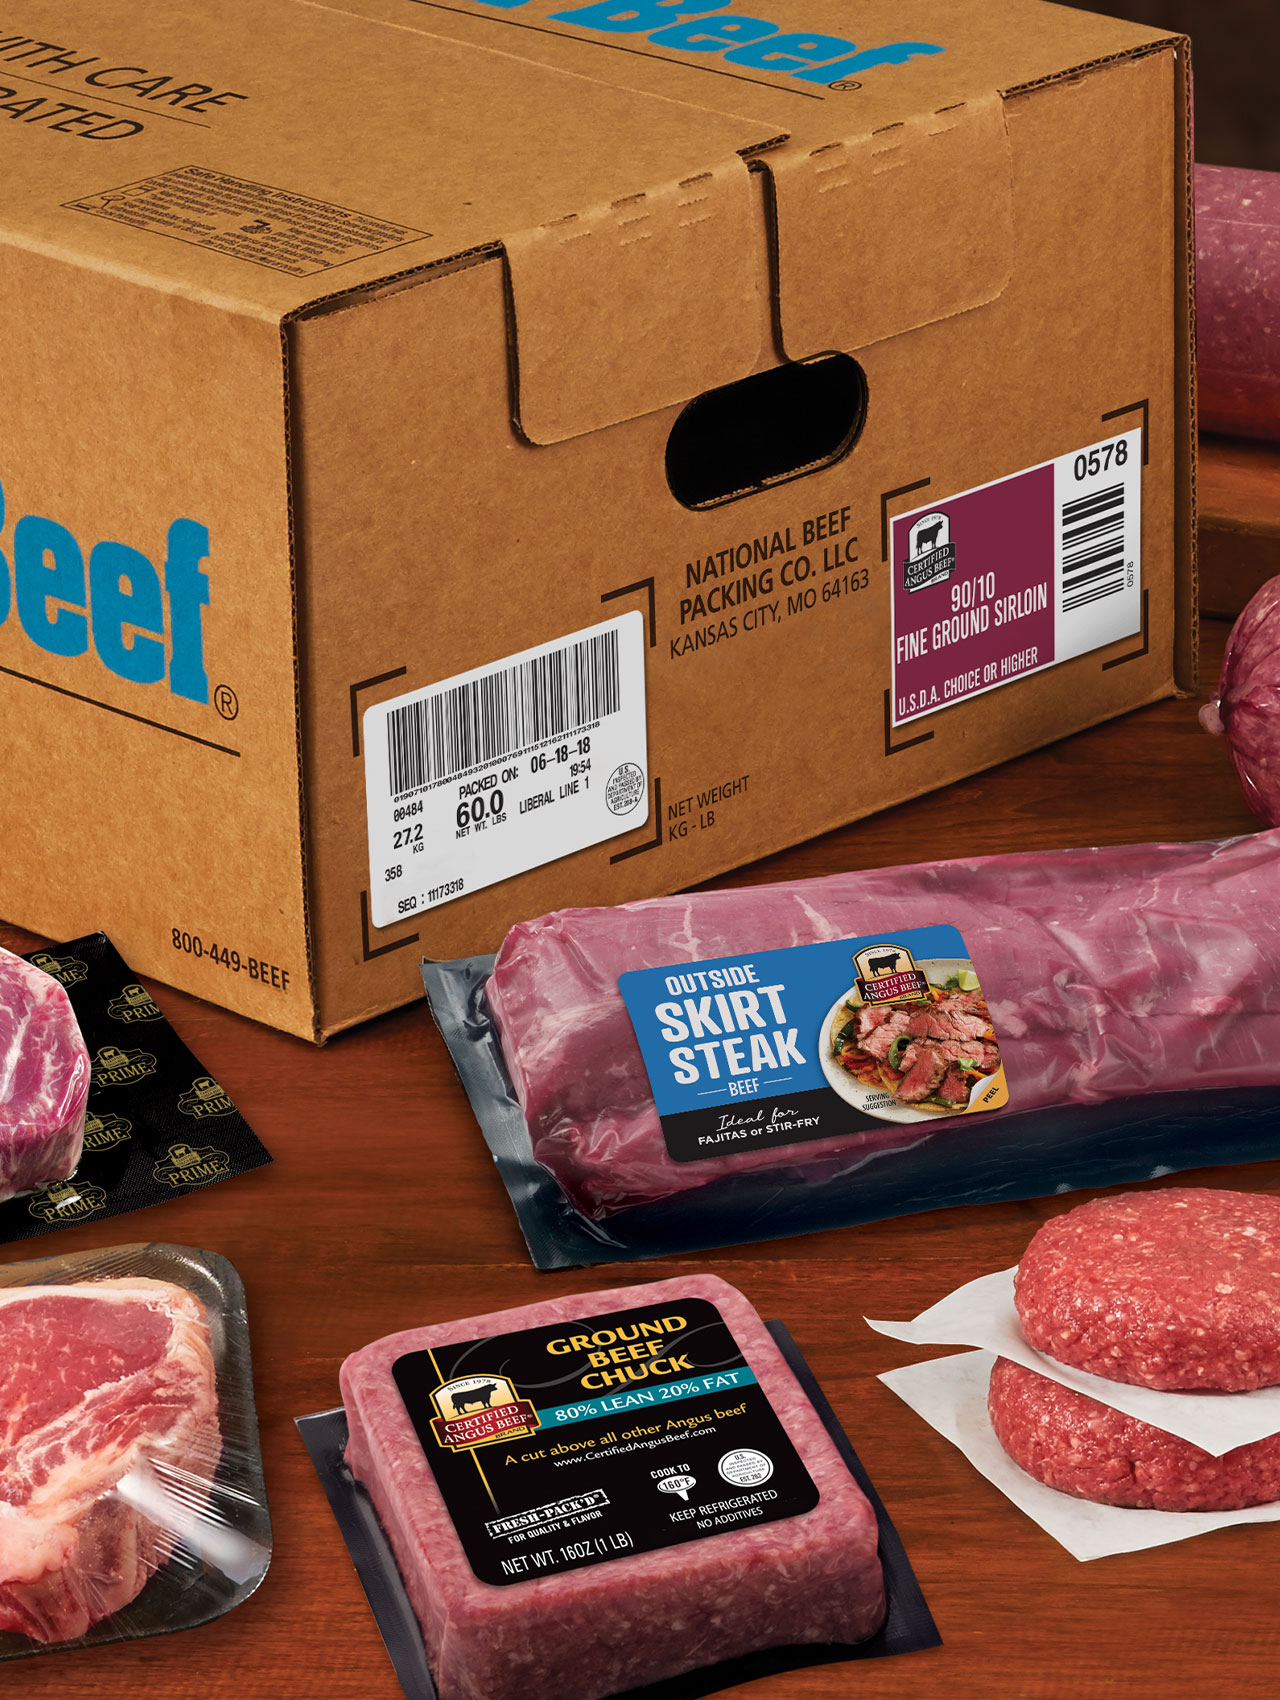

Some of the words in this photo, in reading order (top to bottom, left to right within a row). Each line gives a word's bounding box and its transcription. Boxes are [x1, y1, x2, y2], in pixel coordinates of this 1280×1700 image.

[85, 66, 249, 113] CARE
[1074, 439, 1128, 481] 0578
[686, 528, 796, 588] NATIONAL
[803, 506, 851, 546] BEEF
[680, 569, 773, 625] PACKING
[780, 555, 816, 586] CO.
[824, 537, 858, 572] LLC
[951, 571, 995, 612] 90/10
[670, 617, 738, 659] KANSAS
[743, 601, 781, 631] CITY,
[788, 588, 817, 616] MO
[822, 569, 869, 602] 64163
[897, 628, 928, 664] FINE
[932, 605, 989, 650] GROUND
[995, 582, 1047, 626] SIRLOIN
[899, 685, 940, 716] U.S.D.A.
[944, 669, 980, 698] CHOICE
[983, 662, 997, 683] OR
[1001, 647, 1038, 676] HIGHER
[459, 775, 497, 799] PACKED
[502, 767, 519, 786] ON:
[531, 737, 590, 773] 06-18-18
[570, 758, 591, 777] 19:54
[394, 800, 423, 822] 00484
[456, 790, 504, 828] 60.0
[520, 790, 555, 814] LIBERAL
[560, 782, 579, 799] LINE
[668, 797, 693, 820] NET
[697, 775, 750, 809] WEIGHT
[393, 824, 423, 849] 27.2
[456, 826, 470, 839] NET
[475, 821, 487, 832] WT.
[492, 813, 507, 825] LBS
[669, 821, 688, 842] KG
[700, 810, 715, 829] LB
[413, 842, 424, 854] KG
[385, 865, 402, 881] 358
[398, 896, 416, 913] SEQ
[427, 878, 463, 901] 11173318
[172, 928, 290, 990] 800-449-BEEF
[664, 963, 759, 996] OUTSIDE
[655, 984, 786, 1043] SKIRT
[97, 1062, 153, 1086] PRIME
[669, 1028, 807, 1085] STEAK
[728, 1078, 760, 1097] BEEF
[982, 1085, 1000, 1103] PEEL
[698, 1129, 748, 1146] FAJITAS
[751, 1128, 763, 1136] or
[766, 1116, 820, 1134] STIR-FRY
[169, 1160, 224, 1187] PRIME
[546, 1316, 687, 1355] GROUND
[581, 1353, 694, 1390] CHUCK
[587, 1340, 664, 1369] BEEF
[554, 1404, 597, 1423] 80%
[602, 1391, 654, 1413] LEAN
[658, 1381, 700, 1401] 20%
[703, 1372, 739, 1389] FAT
[444, 1424, 494, 1443] ANGUS
[445, 1405, 518, 1433] CERTIFIED
[554, 1425, 717, 1467] www.CertifiedAngusBeef.com
[669, 1508, 697, 1523] KEEP
[699, 1489, 778, 1516] REFRIGERATED
[697, 1518, 713, 1530] NO
[715, 1506, 764, 1526] ADDITIVES
[501, 1555, 529, 1576] NET
[531, 1549, 559, 1568] WT.
[560, 1540, 595, 1560] 16OZ
[594, 1537, 607, 1555] (1
[609, 1531, 634, 1549] LB)
